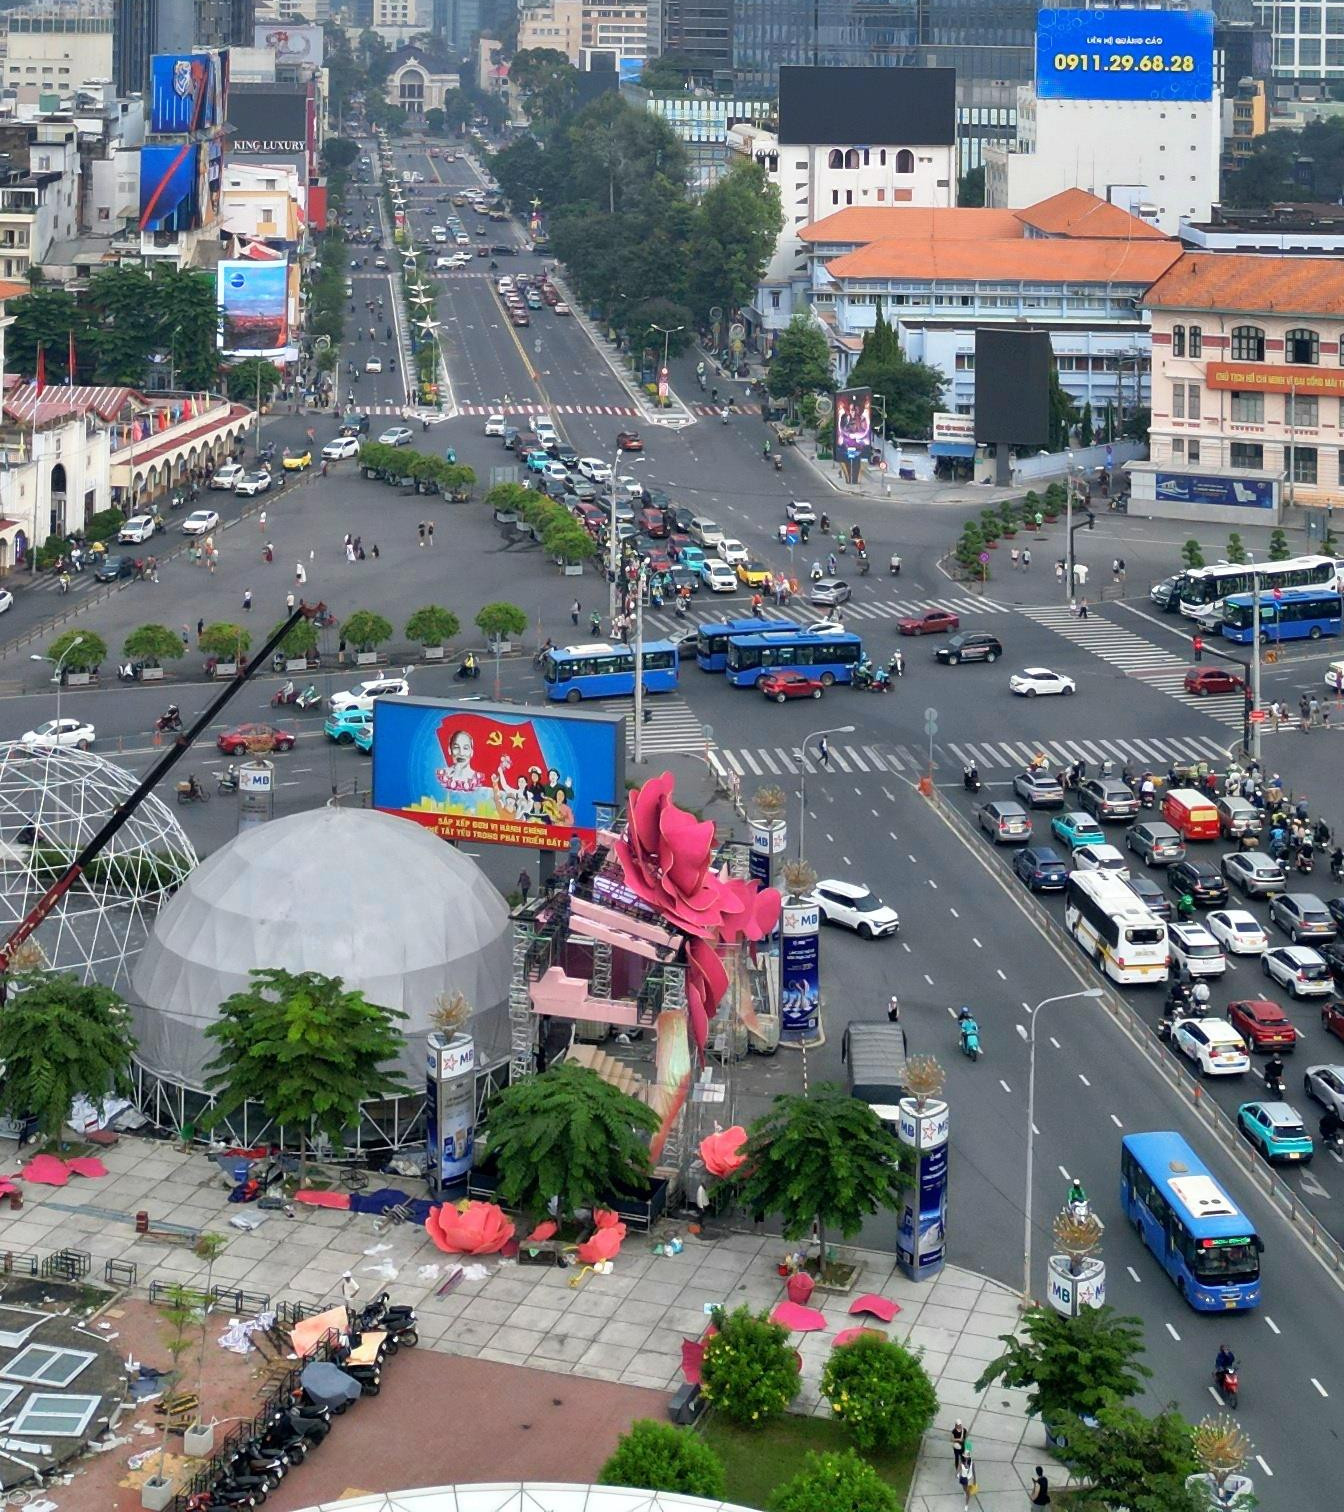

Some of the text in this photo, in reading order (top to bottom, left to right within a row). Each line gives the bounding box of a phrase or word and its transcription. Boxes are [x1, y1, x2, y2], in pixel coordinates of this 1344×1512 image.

[1054, 54, 1194, 72] 0911.29.68.28
[234, 140, 305, 151] KING LUXURY
[252, 775, 269, 785] MB
[801, 912, 817, 926] MB
[1053, 1281, 1071, 1304] MB
